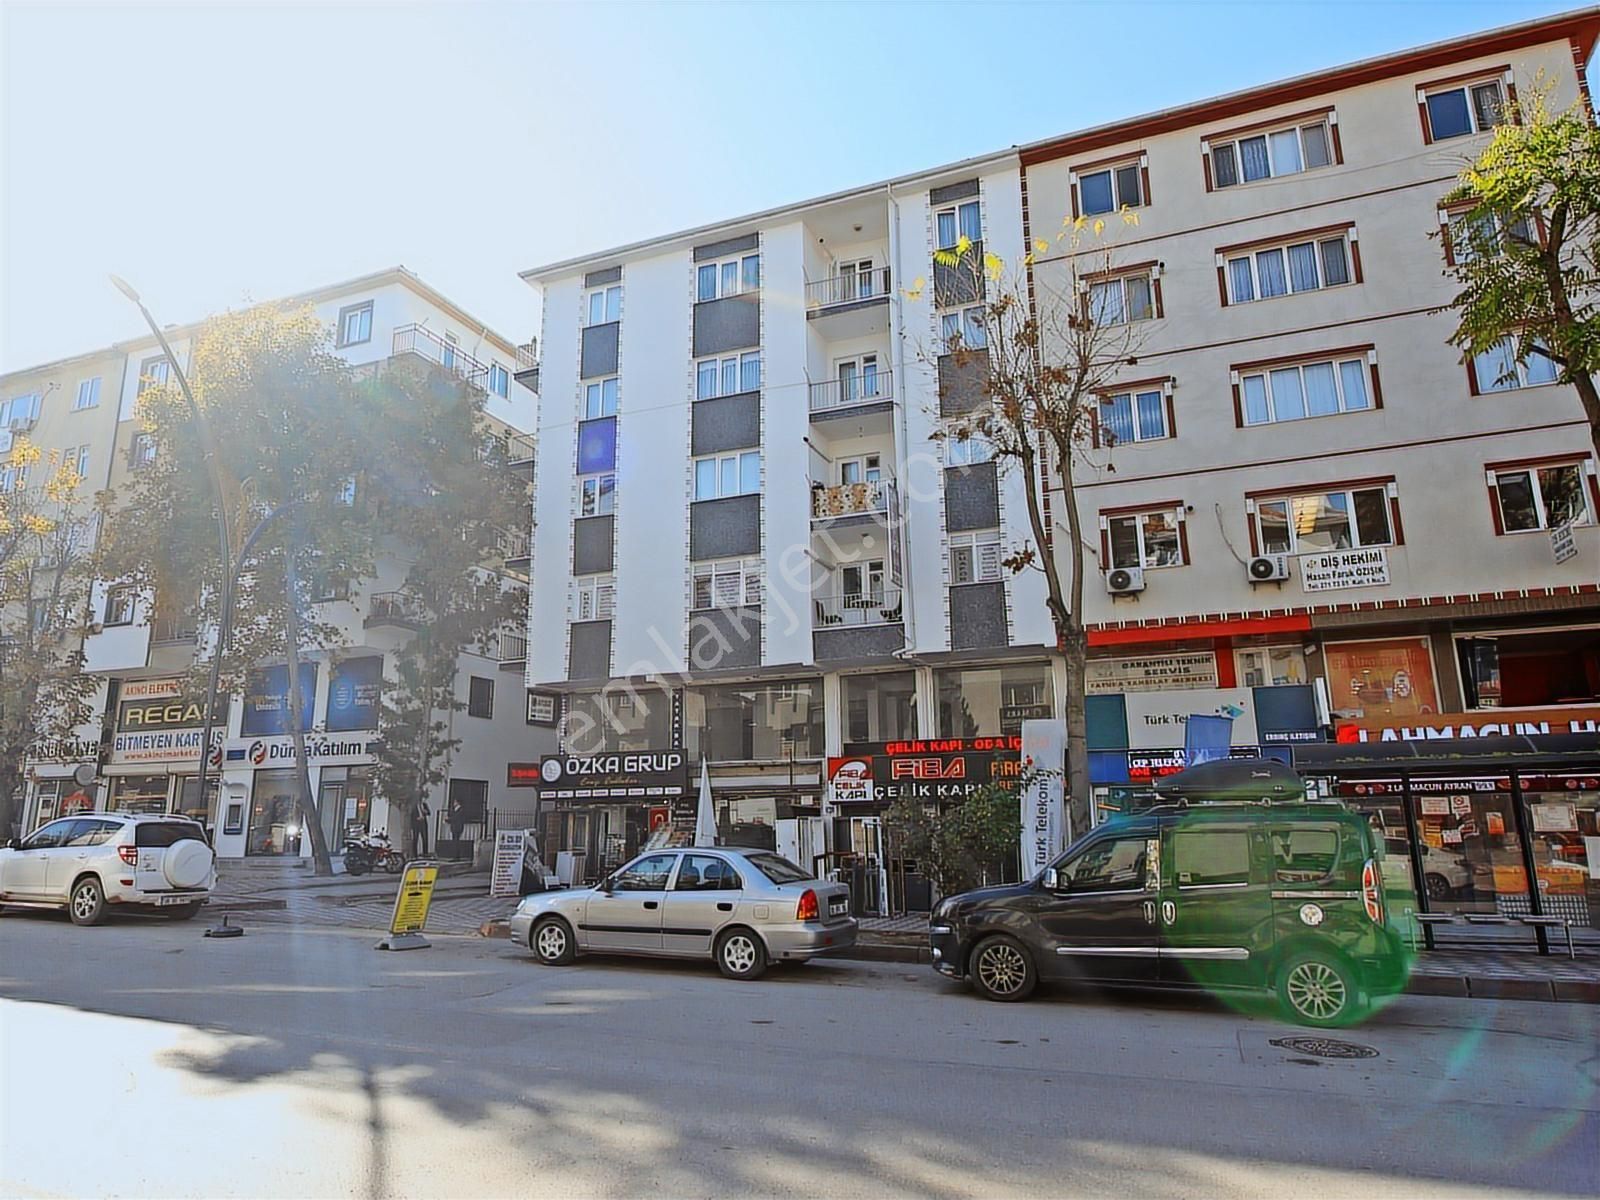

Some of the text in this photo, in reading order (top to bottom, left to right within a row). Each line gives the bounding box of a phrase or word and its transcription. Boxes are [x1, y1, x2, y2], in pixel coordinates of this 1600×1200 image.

[1320, 550, 1382, 568] DİŞ HEKİMİ
[1143, 714, 1169, 725] Türk
[115, 732, 172, 751] BİTMEYEN
[886, 740, 926, 755] ÇELİK
[930, 739, 962, 751] KAPI
[566, 753, 681, 775] ÖZKA GRUP
[835, 790, 867, 800] KAPI
[1394, 782, 1442, 792] LAMACUN
[1034, 778, 1048, 867] Türk Telekom
